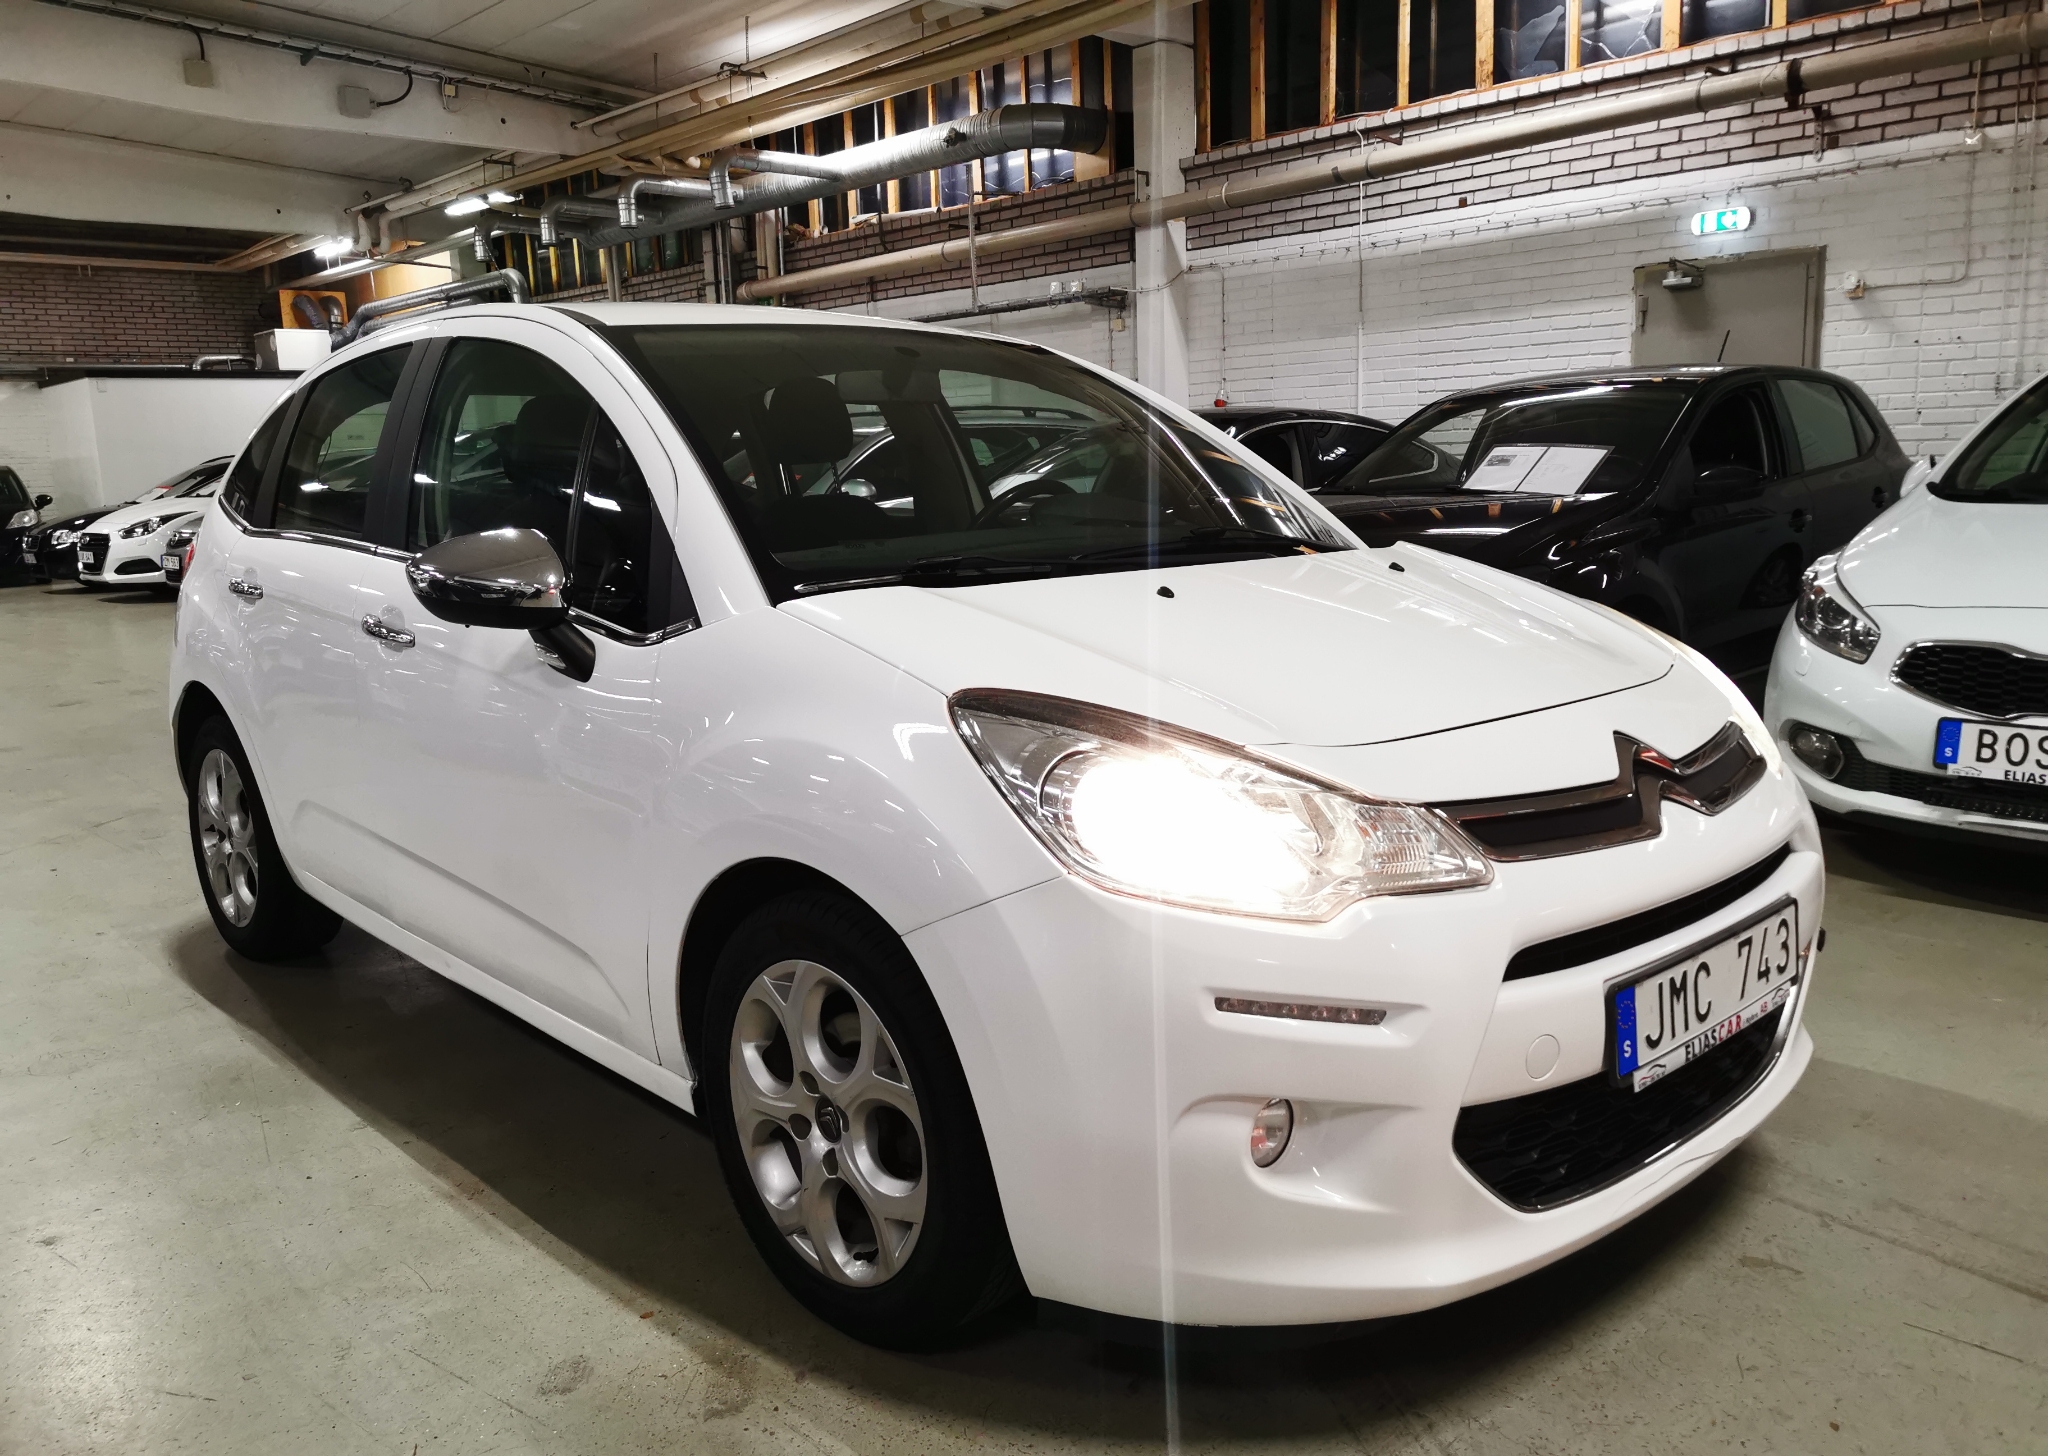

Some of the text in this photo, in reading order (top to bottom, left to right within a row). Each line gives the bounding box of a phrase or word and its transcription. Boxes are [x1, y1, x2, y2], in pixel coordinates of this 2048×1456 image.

[1944, 728, 2048, 770] S BOS
[2004, 769, 2047, 784] ELIAS
[1623, 918, 1791, 1058] S JMC 743
